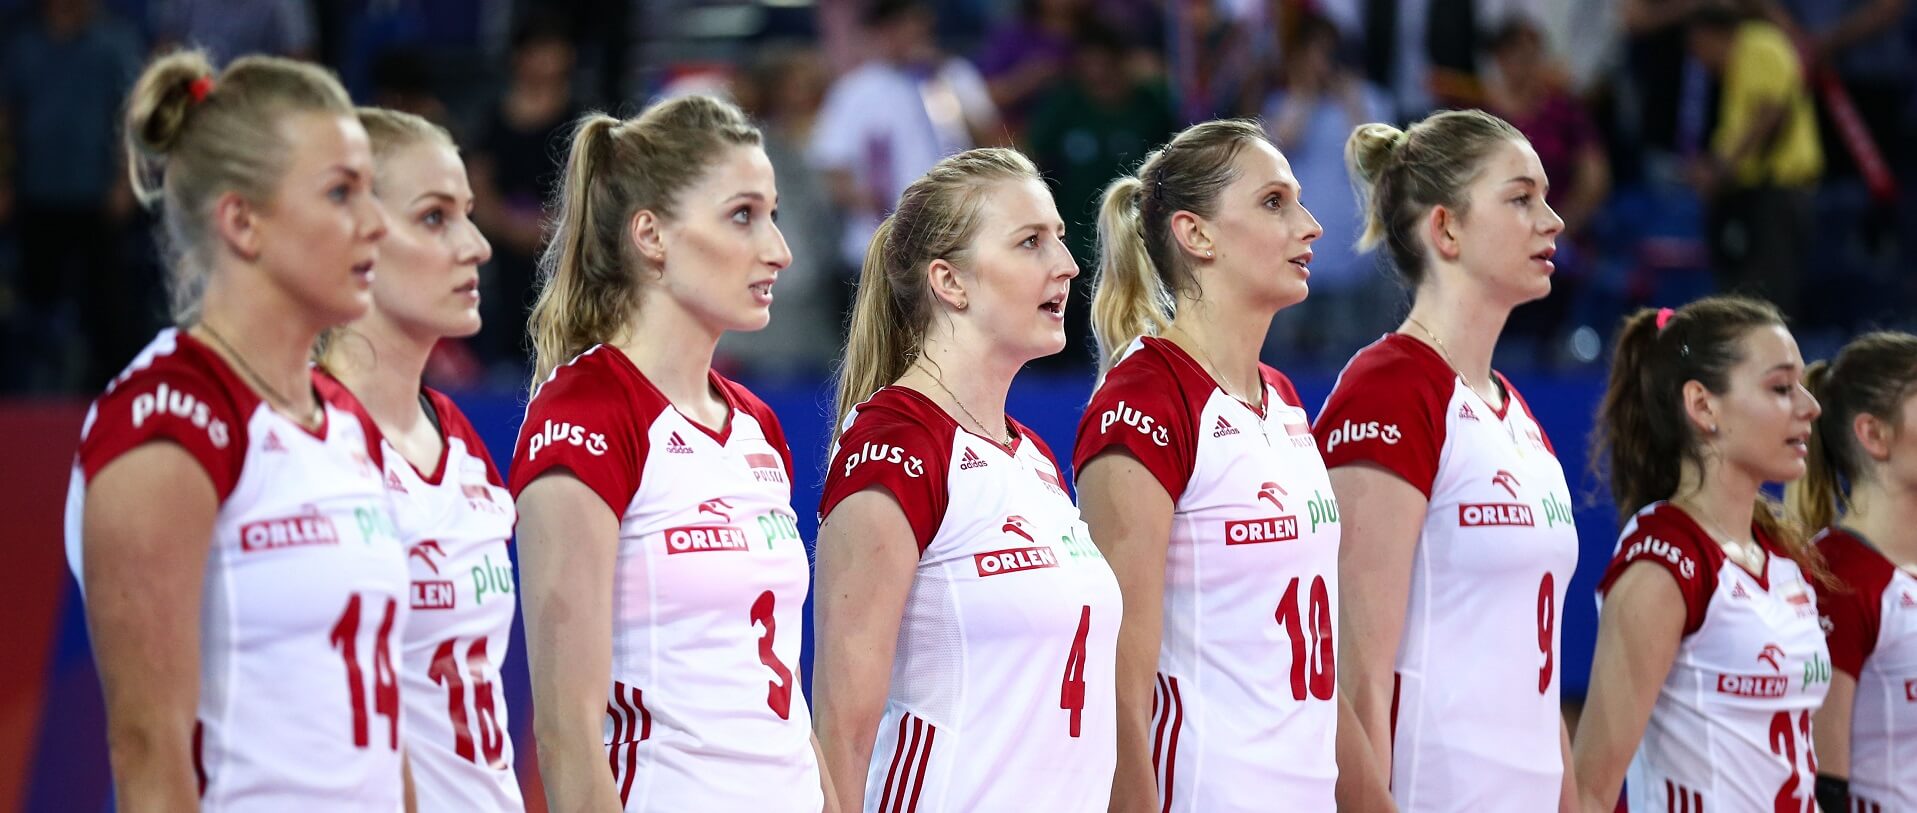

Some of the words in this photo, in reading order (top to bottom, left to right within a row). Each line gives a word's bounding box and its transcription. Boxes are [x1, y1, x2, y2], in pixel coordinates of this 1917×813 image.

[131, 382, 211, 429] plus
[1101, 401, 1155, 434] plus
[529, 419, 585, 462] plus
[1213, 427, 1241, 439] adidas
[1327, 420, 1380, 452] plus
[845, 441, 905, 478] plus
[960, 459, 988, 471] adidas
[1462, 504, 1533, 527] ORLEN
[1541, 491, 1574, 529] plu
[669, 529, 747, 552] ORLEN
[757, 508, 798, 551] plu
[1061, 526, 1104, 565] plu
[1229, 518, 1297, 543] ORLEN
[980, 548, 1057, 574] ORLEN
[1625, 534, 1682, 564] plus
[410, 582, 455, 609] LEN
[1275, 574, 1335, 700] 10
[1537, 572, 1554, 695] 9
[331, 592, 398, 752] 14
[750, 589, 792, 721] 3
[1060, 605, 1090, 737] 4
[1801, 651, 1831, 693] plu
[429, 636, 508, 770] 16
[1721, 675, 1787, 697] ORLEN
